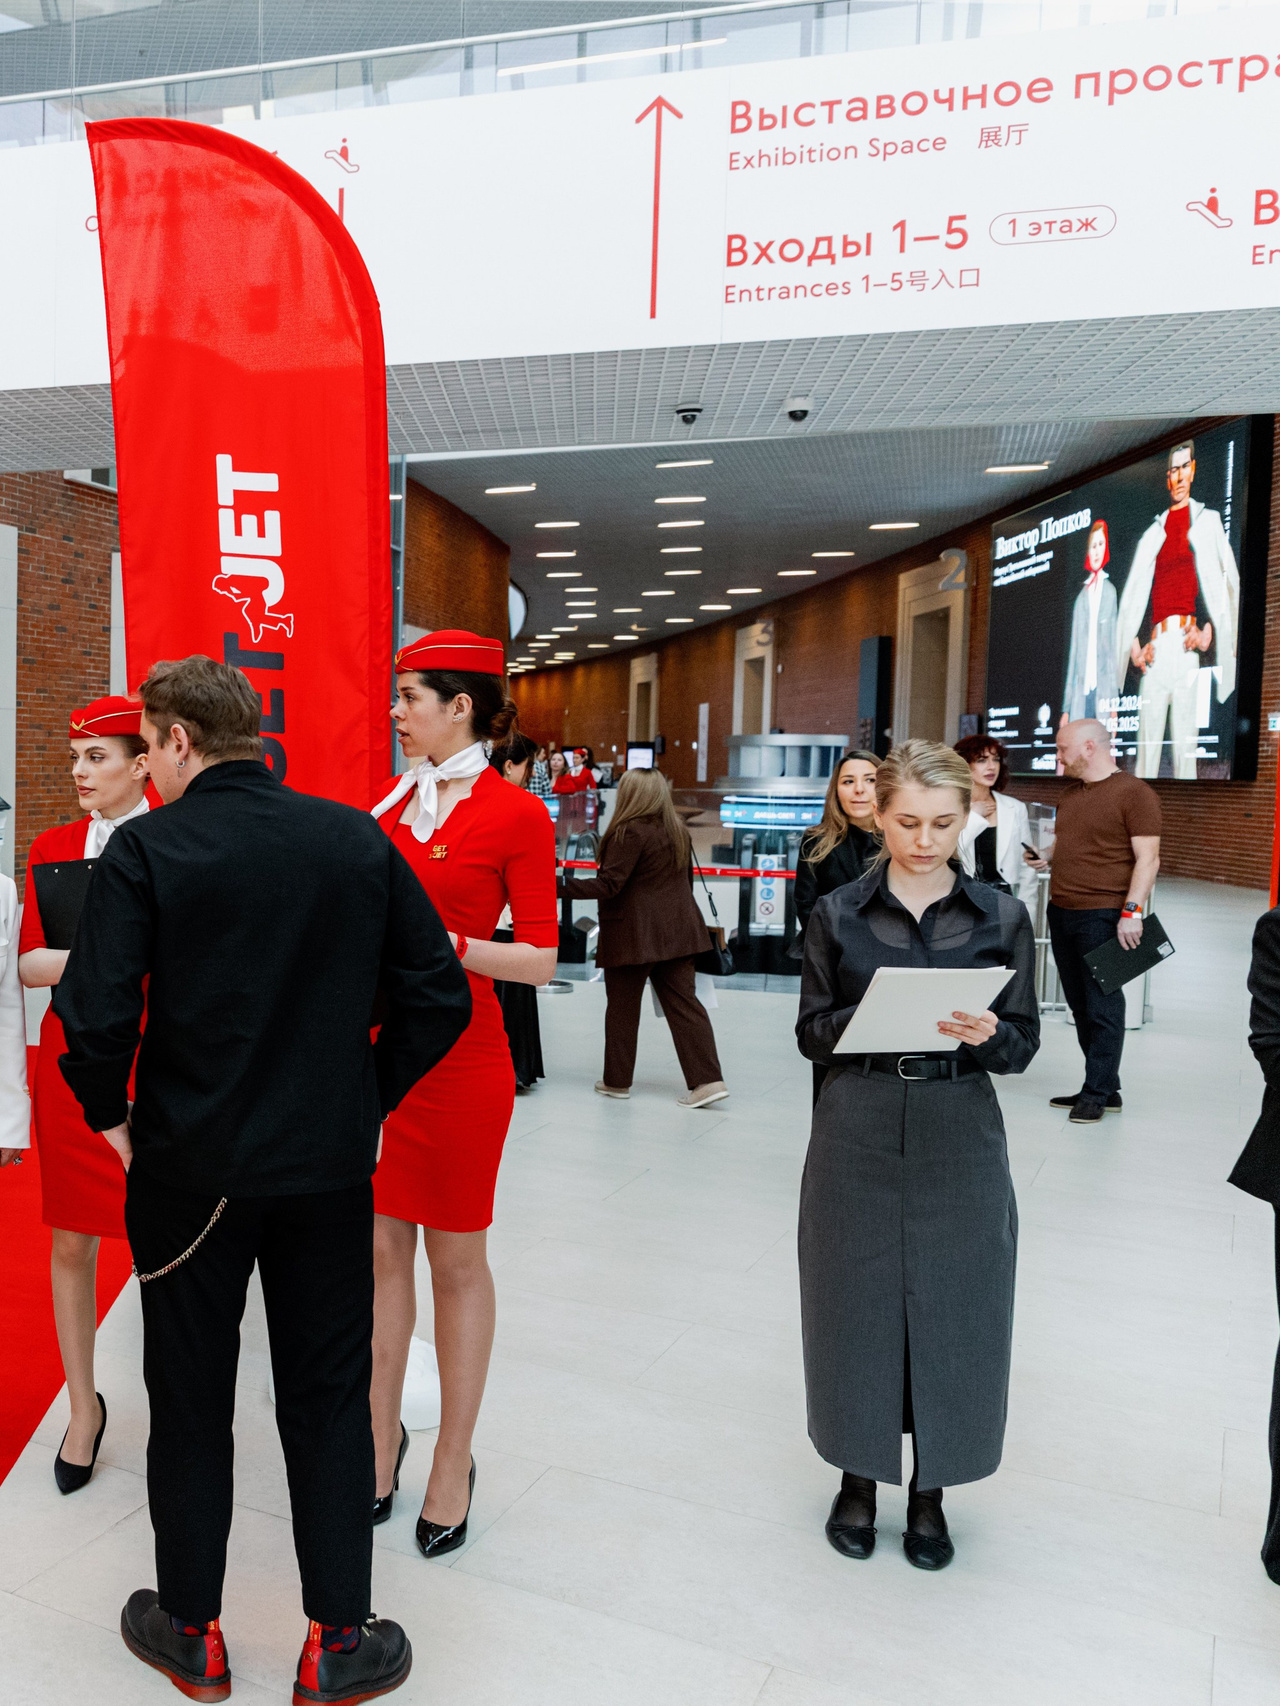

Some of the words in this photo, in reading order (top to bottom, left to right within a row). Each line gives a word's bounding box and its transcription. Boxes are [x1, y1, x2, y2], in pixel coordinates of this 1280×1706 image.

[730, 77, 1054, 134] Выставочное
[729, 142, 858, 171] Exhibition
[868, 136, 947, 162] Space
[977, 123, 1029, 149] 展厅
[1007, 218, 1017, 238] 1
[1028, 216, 1098, 236] этаж
[726, 232, 873, 267] Входы
[725, 280, 852, 303] Entrances
[215, 453, 286, 607] JET
[938, 548, 968, 592] 2
[755, 619, 775, 647] 3
